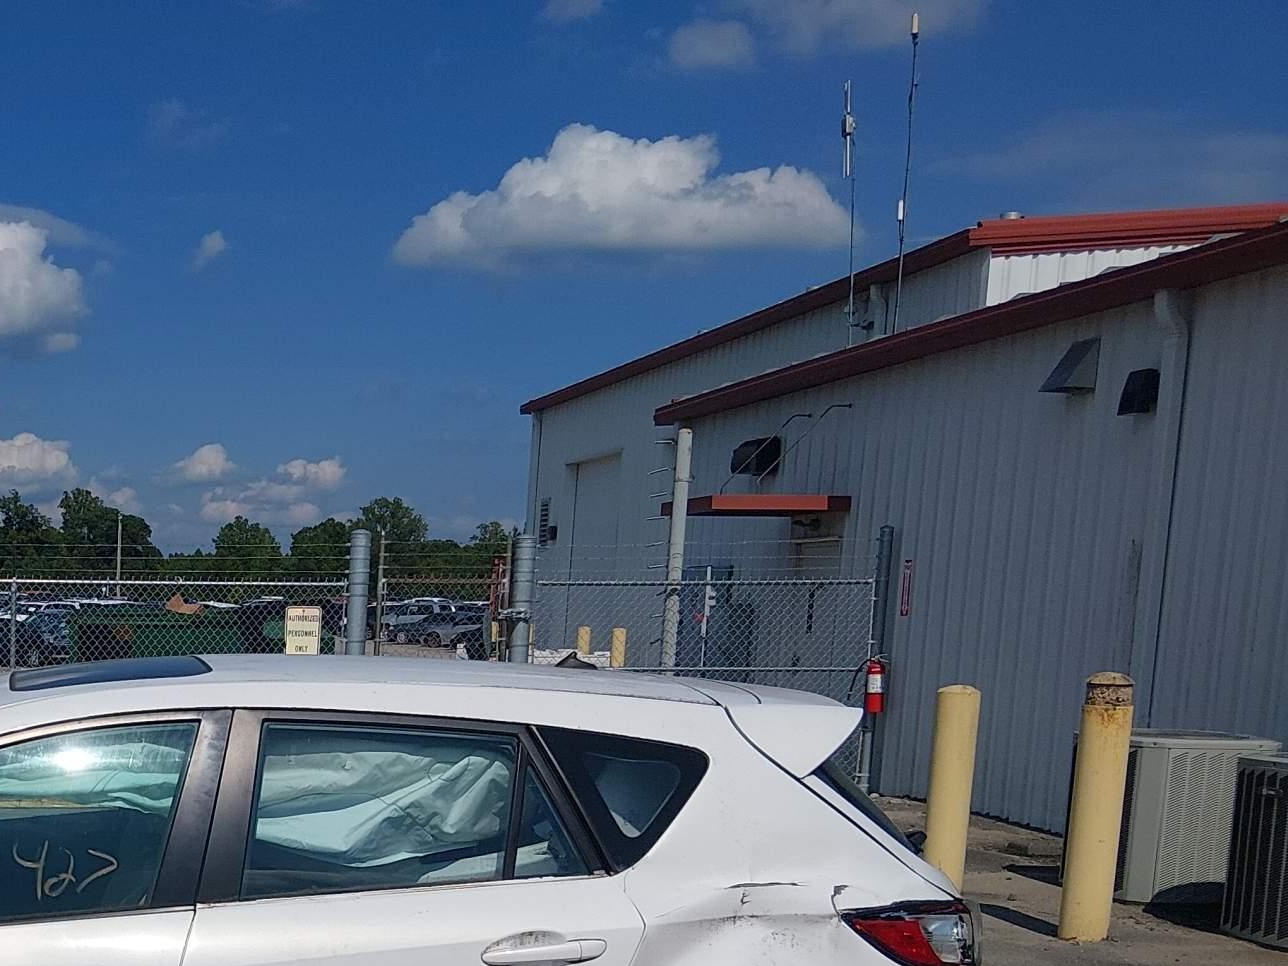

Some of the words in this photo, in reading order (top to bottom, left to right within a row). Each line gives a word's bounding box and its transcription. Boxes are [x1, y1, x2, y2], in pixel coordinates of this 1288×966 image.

[288, 615, 319, 623] AUTHORIZED
[288, 629, 317, 638] PERSONNEL
[295, 645, 309, 653] ONLY
